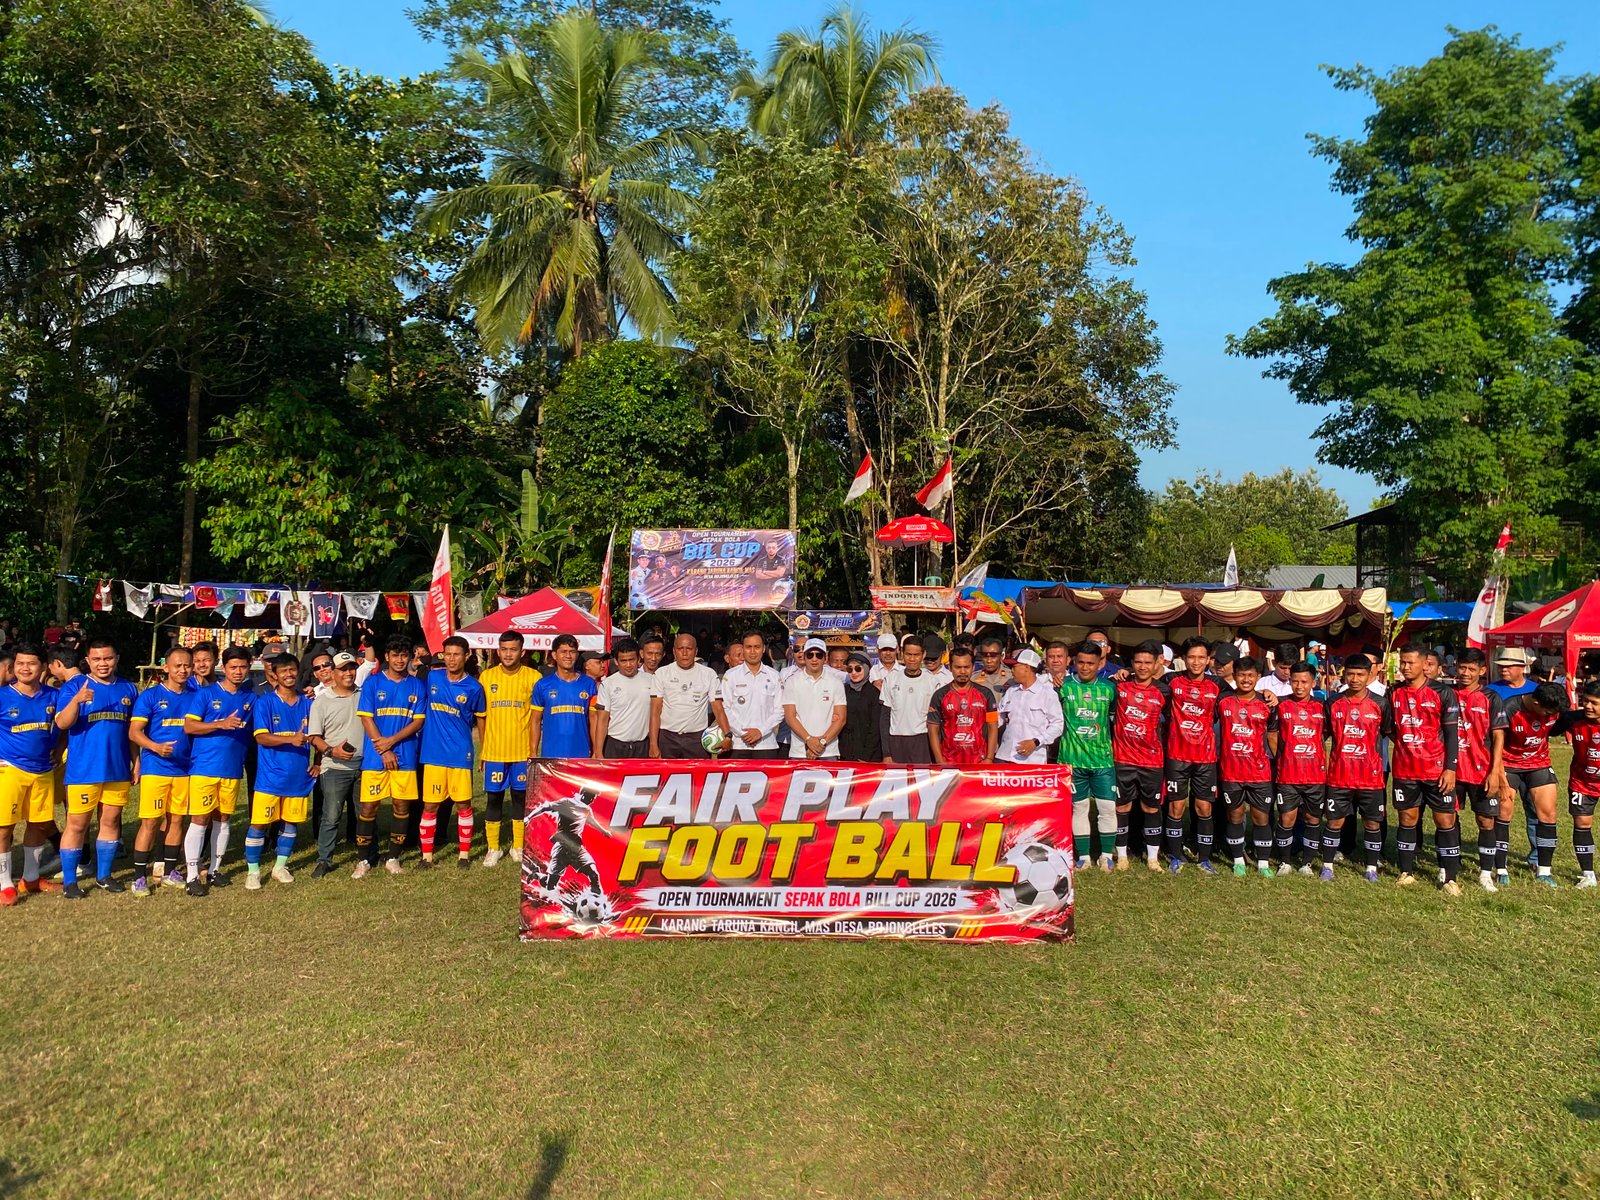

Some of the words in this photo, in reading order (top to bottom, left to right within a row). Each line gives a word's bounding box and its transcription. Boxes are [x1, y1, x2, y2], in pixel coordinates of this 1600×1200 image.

[683, 542, 717, 561] BIL
[721, 541, 761, 559] CUP
[710, 558, 736, 567] 2026
[884, 592, 935, 600] INDONESIA
[818, 618, 835, 629] BIL
[835, 617, 854, 629] CUP
[491, 771, 504, 783] 20
[982, 772, 1058, 788] Telkomsel
[432, 784, 442, 795] 14
[1166, 780, 1178, 793] 24
[80, 794, 89, 805] 5
[609, 770, 769, 827] FAIR
[780, 768, 960, 821] PLAY
[1394, 788, 1405, 802] 16
[1571, 791, 1582, 805] 21
[154, 799, 163, 810] 10
[617, 823, 816, 881] FOOT
[825, 822, 1016, 882] BALL
[657, 891, 692, 907] OPEN
[696, 891, 781, 907] TOURNAMENT
[784, 891, 825, 907] SEPAK
[829, 892, 861, 907] BOLA
[865, 892, 891, 907] BILL
[895, 892, 921, 907] CUP
[924, 892, 957, 907] 2026
[661, 918, 706, 932] KARANG
[712, 918, 754, 932] TARUNA
[760, 920, 801, 933] KANCIL
[805, 920, 830, 934] MAS
[834, 921, 864, 934] DESA
